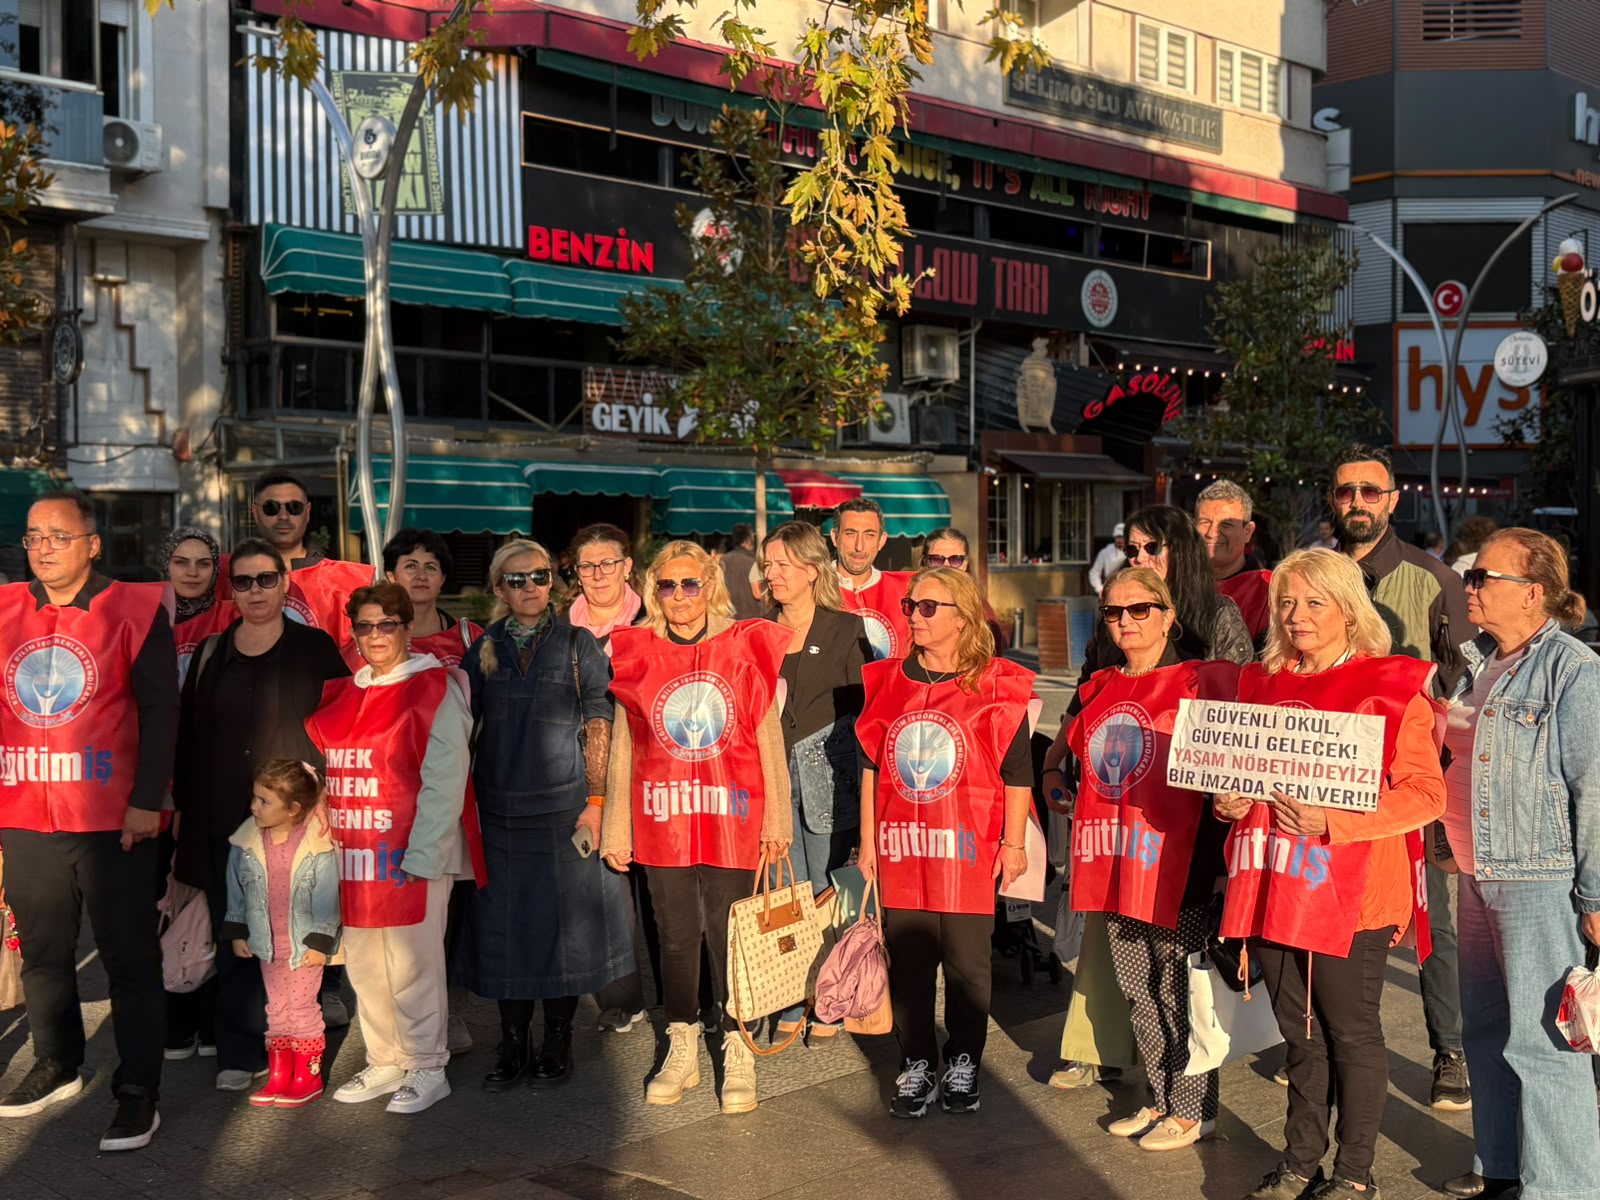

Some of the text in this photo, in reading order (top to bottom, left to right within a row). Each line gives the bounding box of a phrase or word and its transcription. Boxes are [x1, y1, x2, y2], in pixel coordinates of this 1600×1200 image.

[425, 114, 443, 214] MUSIC PERFORMANCE
[528, 226, 654, 273] BENZİN
[992, 257, 1049, 315] TAXI
[592, 393, 672, 436] GEYİK
[1207, 706, 1340, 737] GÜVENLİ OKUL,
[1192, 728, 1358, 759] GÜVENLİ GELECEK!
[1174, 747, 1376, 785] YAŞAM NÖBETİNDEYİZ!
[1169, 767, 1377, 809] BİR İMZADA SEN VER!!!
